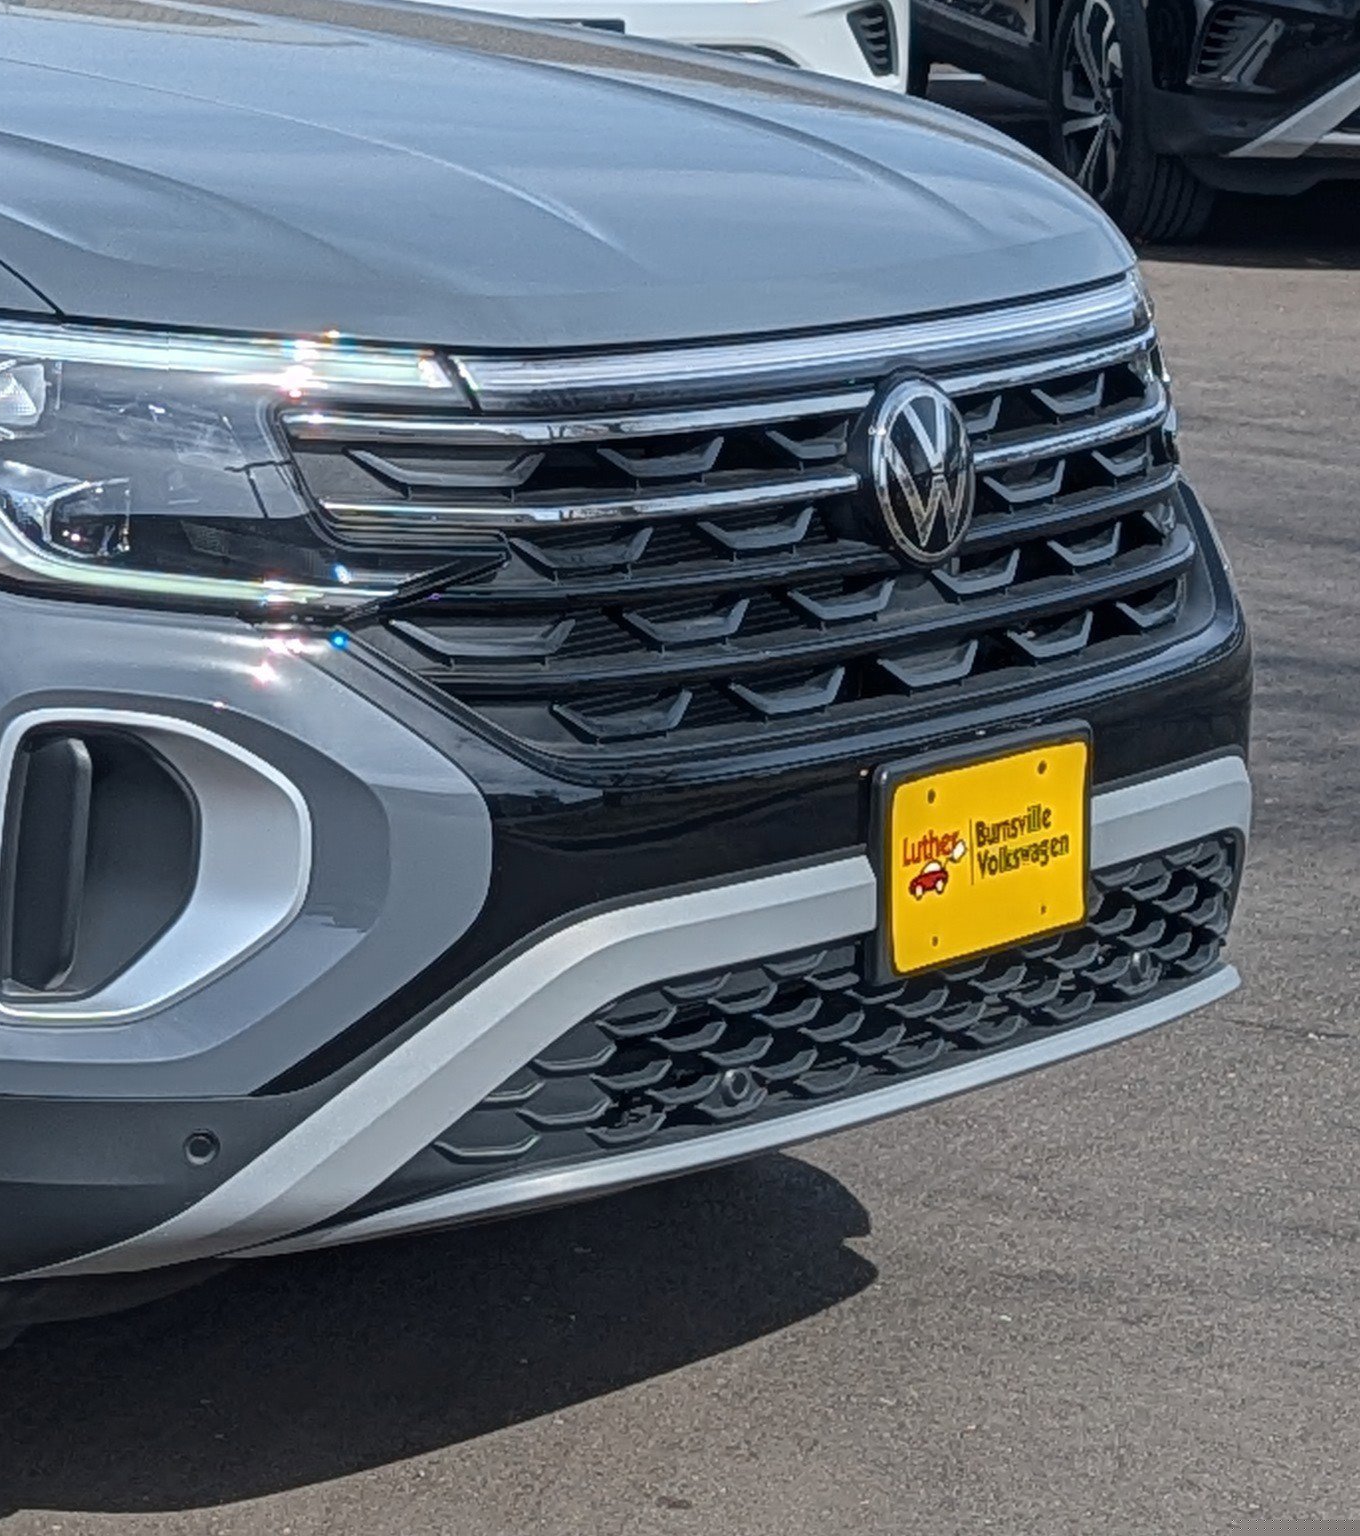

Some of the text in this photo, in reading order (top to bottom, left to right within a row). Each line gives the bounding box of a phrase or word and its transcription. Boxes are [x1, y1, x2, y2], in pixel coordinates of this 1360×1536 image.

[902, 803, 1053, 867] Luther Burnsville
[976, 833, 1070, 880] Volkswagen
